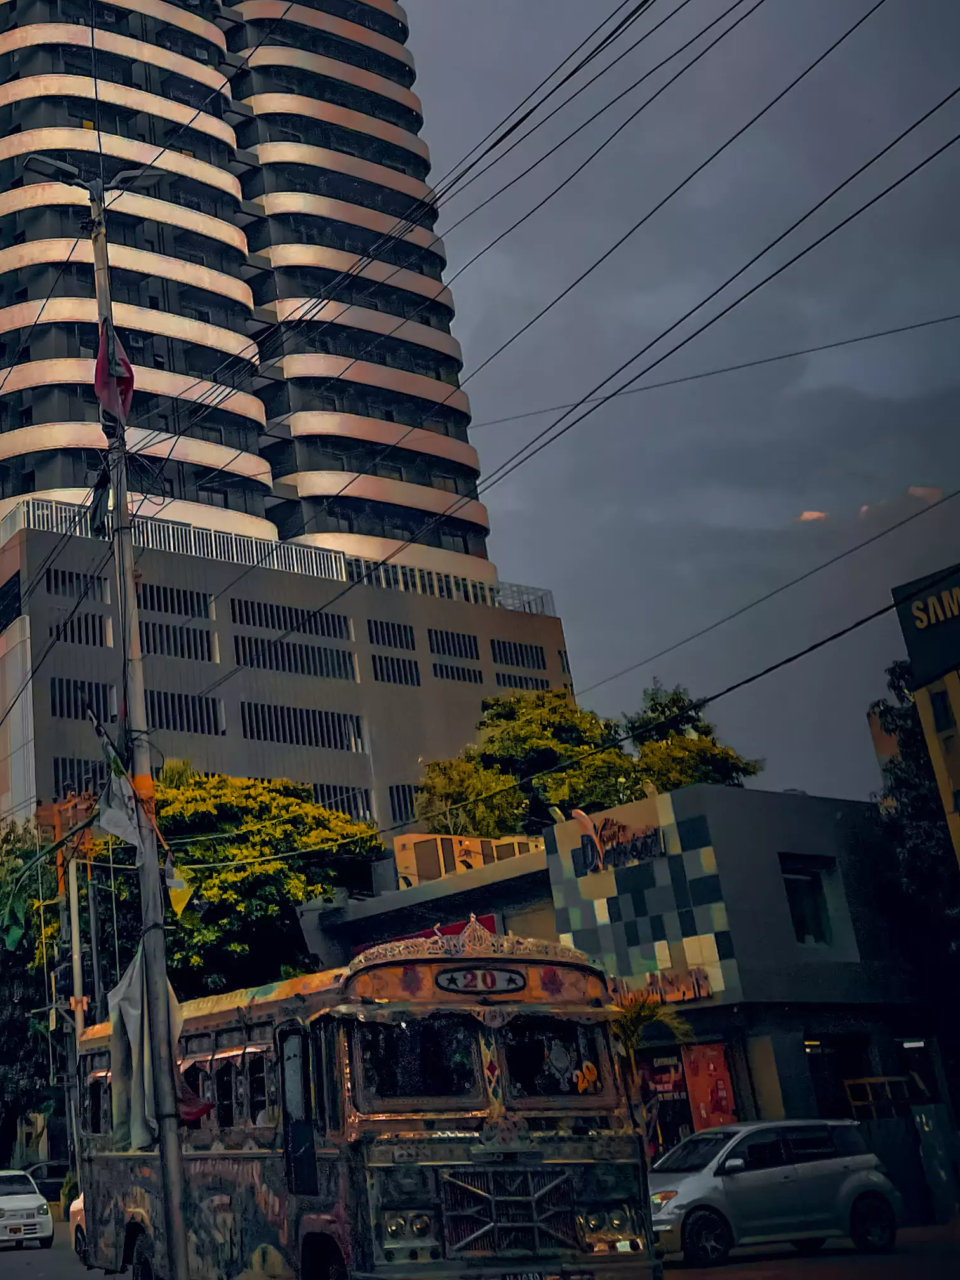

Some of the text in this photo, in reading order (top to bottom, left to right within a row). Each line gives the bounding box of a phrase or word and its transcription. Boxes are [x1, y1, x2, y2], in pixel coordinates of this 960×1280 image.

[911, 586, 960, 629] SAM
[463, 970, 497, 989] 20
[572, 1060, 598, 1094] 20
